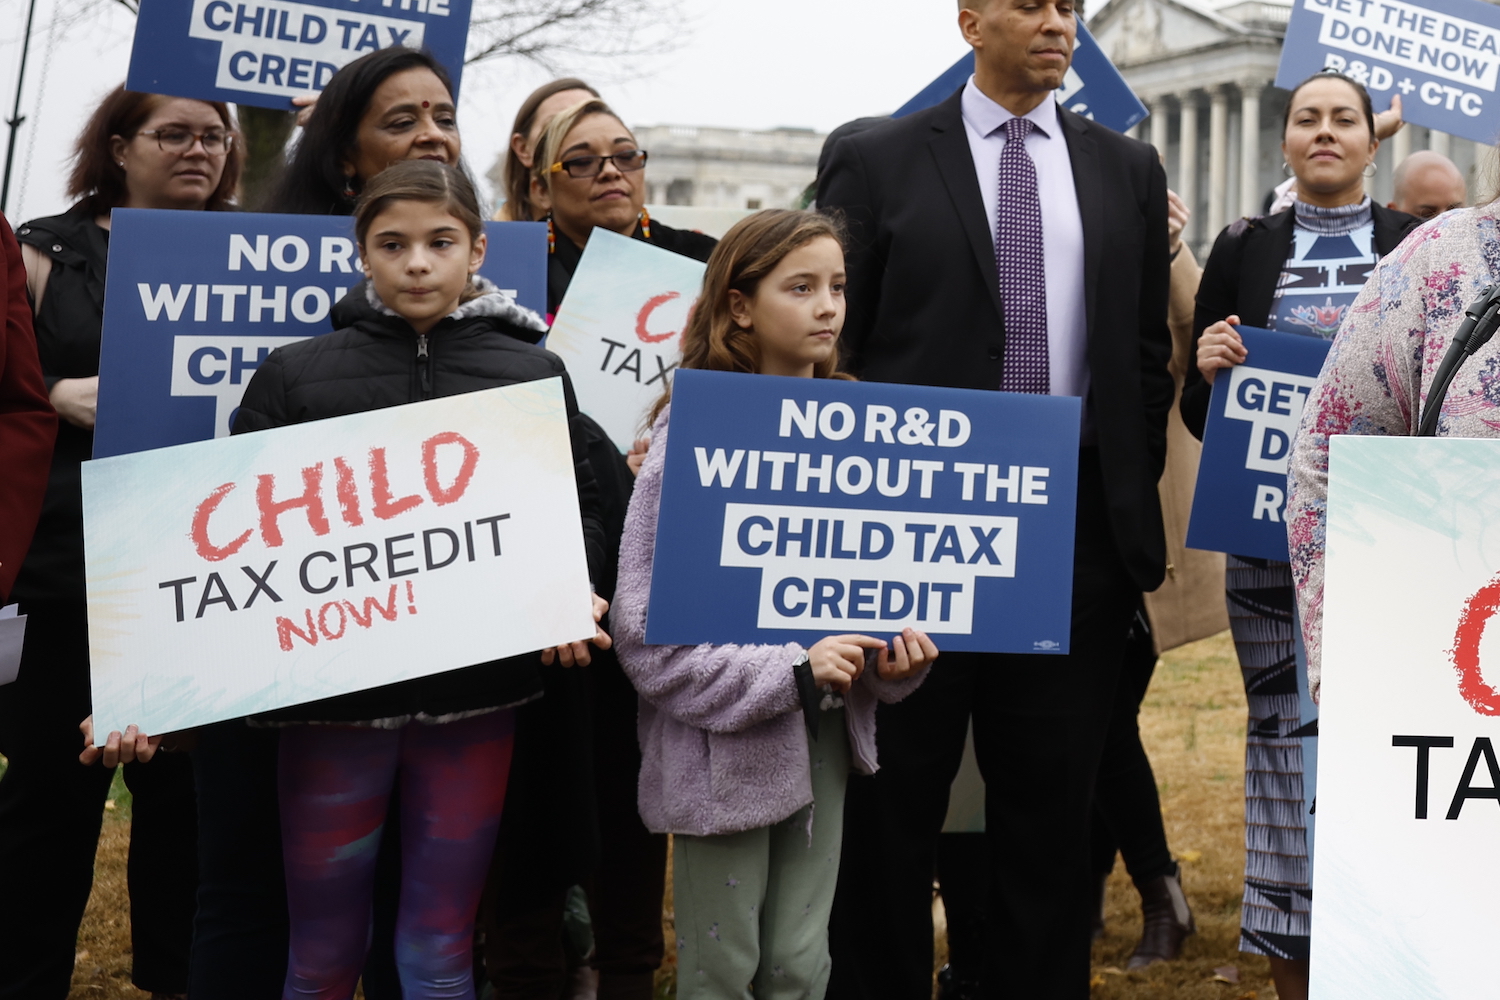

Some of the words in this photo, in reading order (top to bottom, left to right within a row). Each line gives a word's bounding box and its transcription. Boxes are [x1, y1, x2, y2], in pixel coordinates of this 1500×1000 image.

[203, 0, 328, 45] CHILD
[336, 19, 411, 52] TAX
[1379, 3, 1437, 38] THE
[229, 50, 340, 91] CRED
[1329, 19, 1414, 60] DONE
[1418, 44, 1489, 80] NOW
[1419, 80, 1484, 117] CTC
[228, 234, 309, 272] NO
[137, 283, 346, 323] WITHO
[601, 337, 680, 392] TAX
[779, 398, 856, 441] NO
[864, 404, 971, 448] R&D
[185, 431, 480, 562] CHILD
[694, 447, 944, 499] WITHOUT
[954, 463, 1050, 504] THE
[736, 515, 894, 561] CHILD
[905, 523, 1003, 566] TAX
[159, 561, 283, 622] TAX
[299, 513, 511, 595] CREDIT
[276, 580, 418, 652] NOW!
[771, 577, 963, 622] CREDIT
